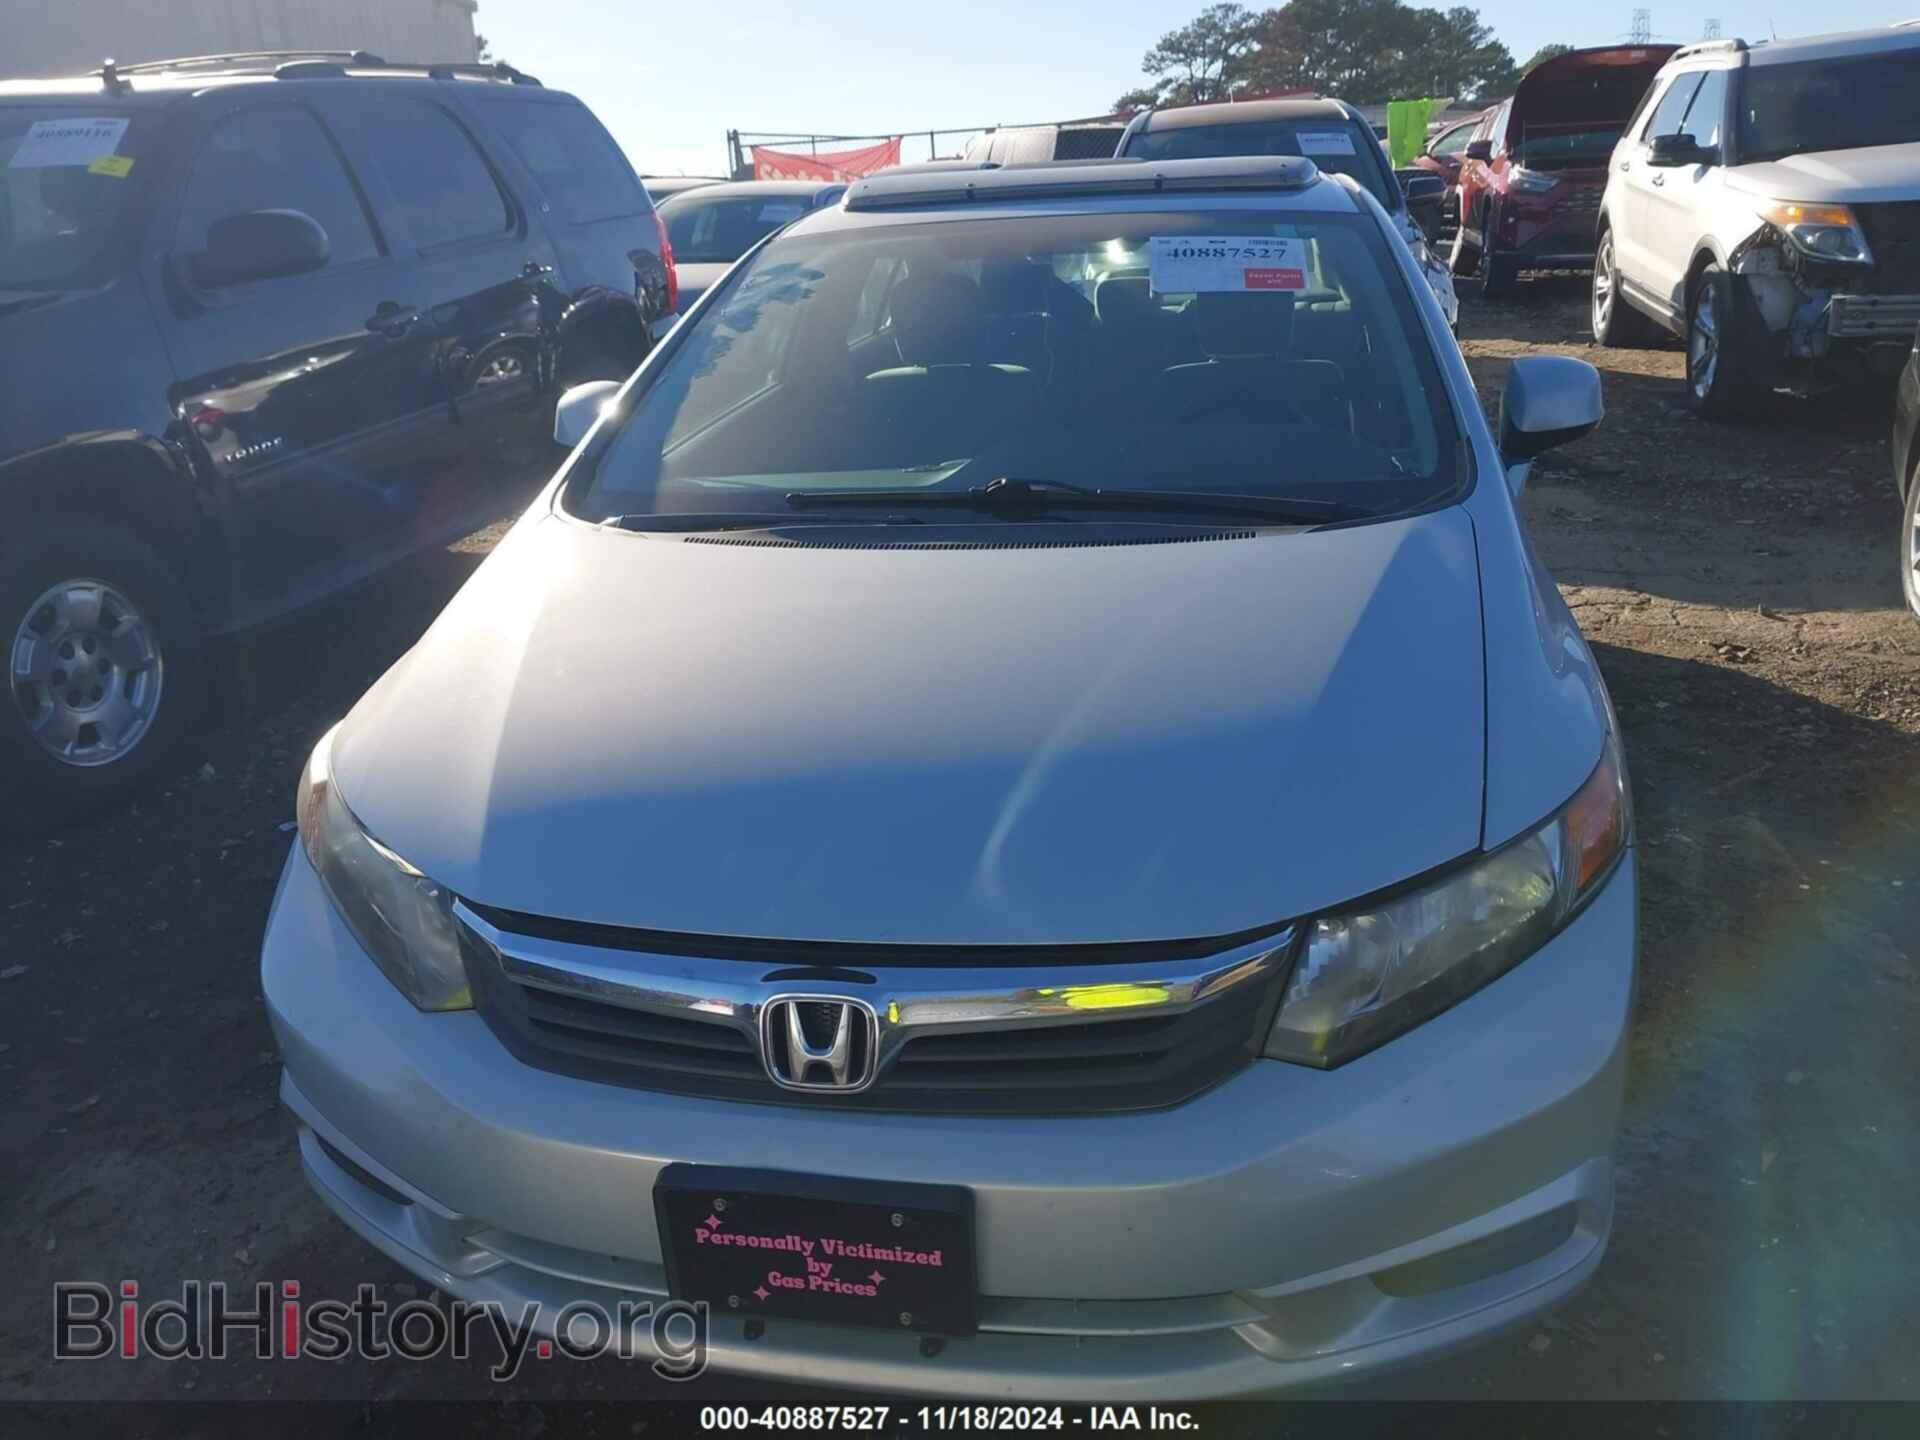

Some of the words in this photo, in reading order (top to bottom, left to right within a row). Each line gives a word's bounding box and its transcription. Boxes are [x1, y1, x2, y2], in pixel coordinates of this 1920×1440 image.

[1166, 247, 1288, 262] 40887527
[695, 1229, 814, 1255] Personally
[820, 1239, 943, 1266] Victimized
[806, 1257, 833, 1276] by
[768, 1272, 805, 1290] Gas
[808, 1275, 877, 1296] Prices
